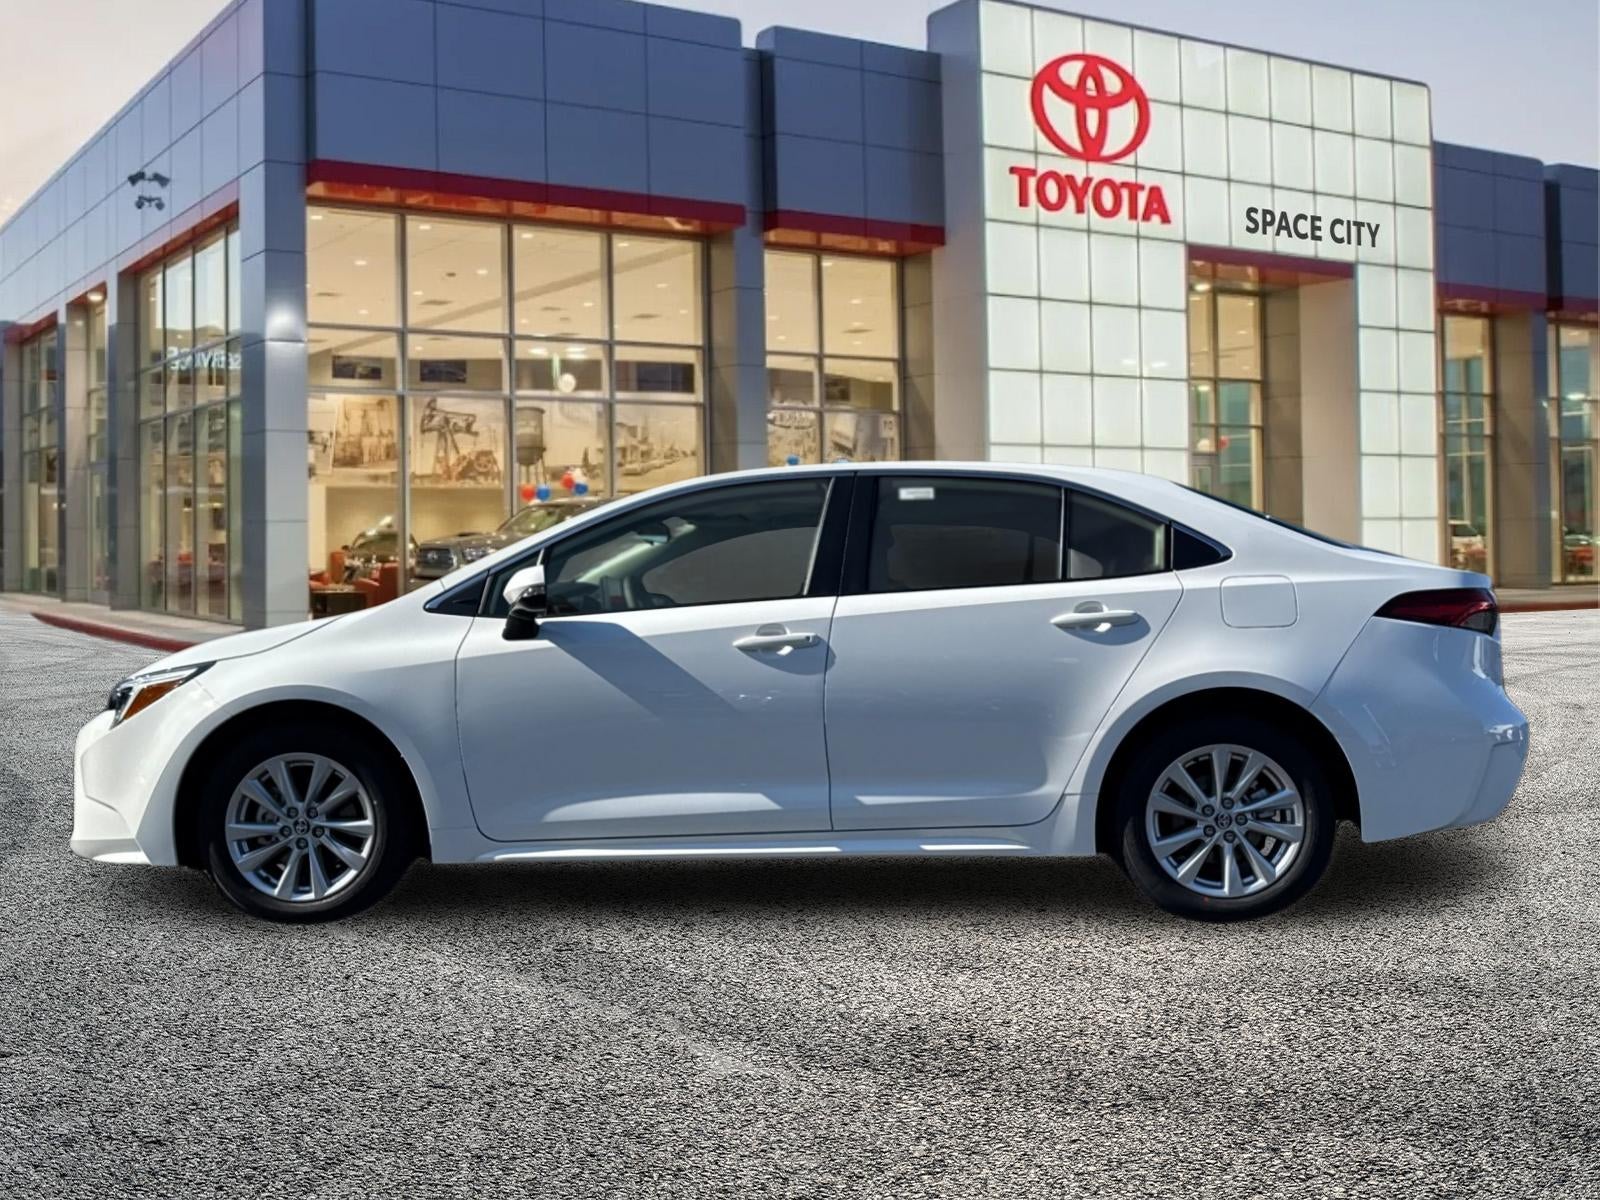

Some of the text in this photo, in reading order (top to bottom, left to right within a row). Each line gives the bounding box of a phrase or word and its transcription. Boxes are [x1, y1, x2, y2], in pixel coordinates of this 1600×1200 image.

[1009, 166, 1171, 224] TOYOTA
[1245, 206, 1380, 247] SPACE CITY
